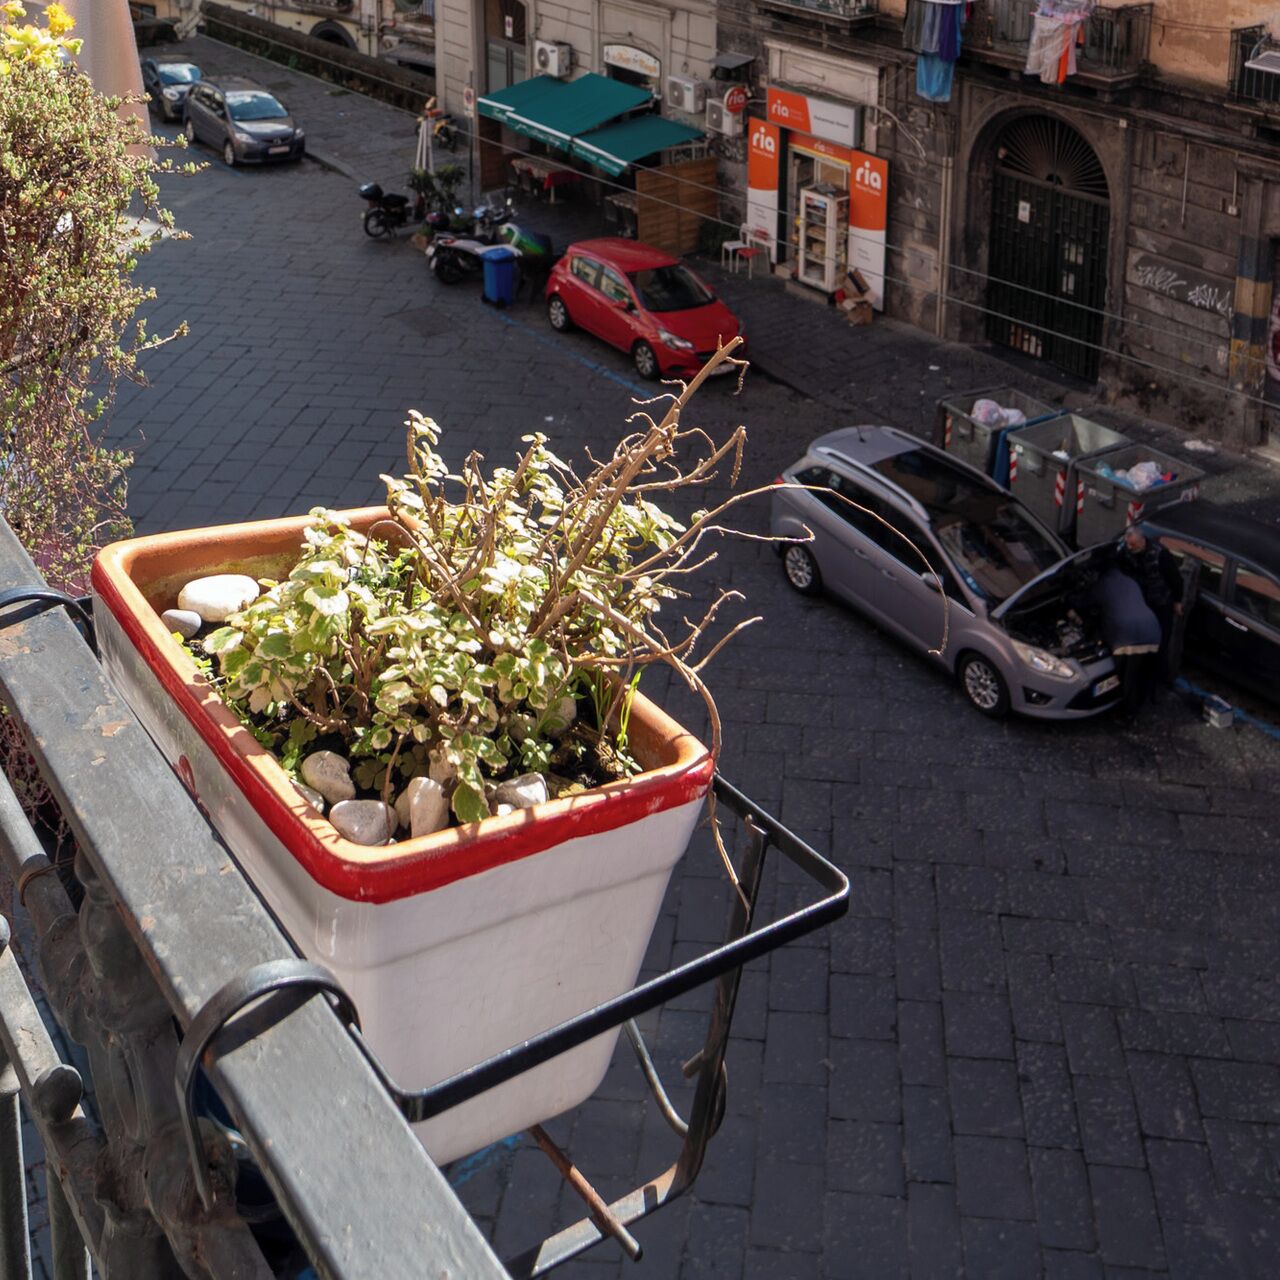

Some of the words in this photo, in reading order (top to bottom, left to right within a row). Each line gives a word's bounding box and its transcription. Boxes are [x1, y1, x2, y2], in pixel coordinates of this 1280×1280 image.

[772, 99, 790, 117] ria
[752, 126, 776, 153] ria
[855, 160, 882, 190] ria
